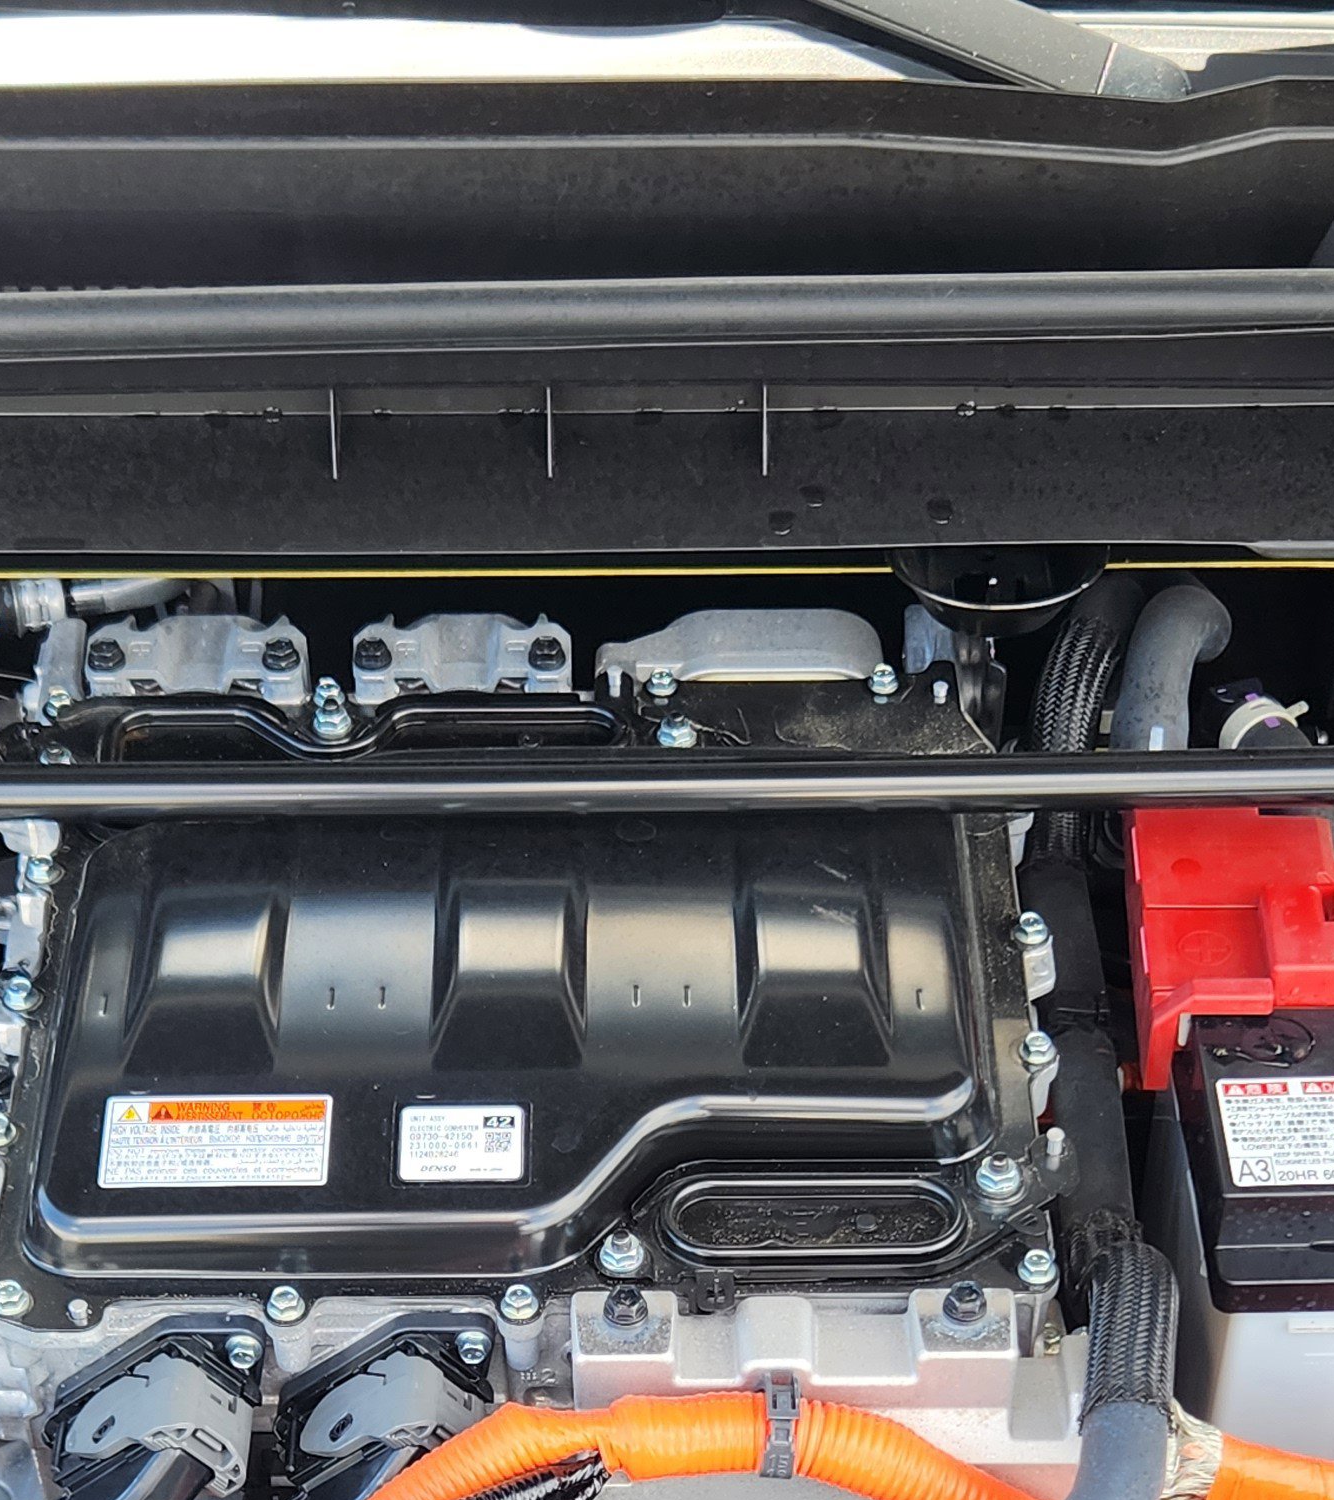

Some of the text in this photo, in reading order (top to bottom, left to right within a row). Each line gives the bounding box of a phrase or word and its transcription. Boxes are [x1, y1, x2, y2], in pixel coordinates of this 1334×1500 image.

[176, 1102, 230, 1111] WARNING
[176, 1112, 243, 1121] AVERTISSEMENT
[486, 1116, 513, 1128] 42
[112, 1126, 128, 1135] HIGH
[130, 1125, 156, 1135] VOLTAGE
[111, 1136, 130, 1145] HAUTE
[133, 1136, 159, 1145] TENSION
[1239, 1159, 1272, 1182] A3
[1278, 1170, 1317, 1181] 20HR
